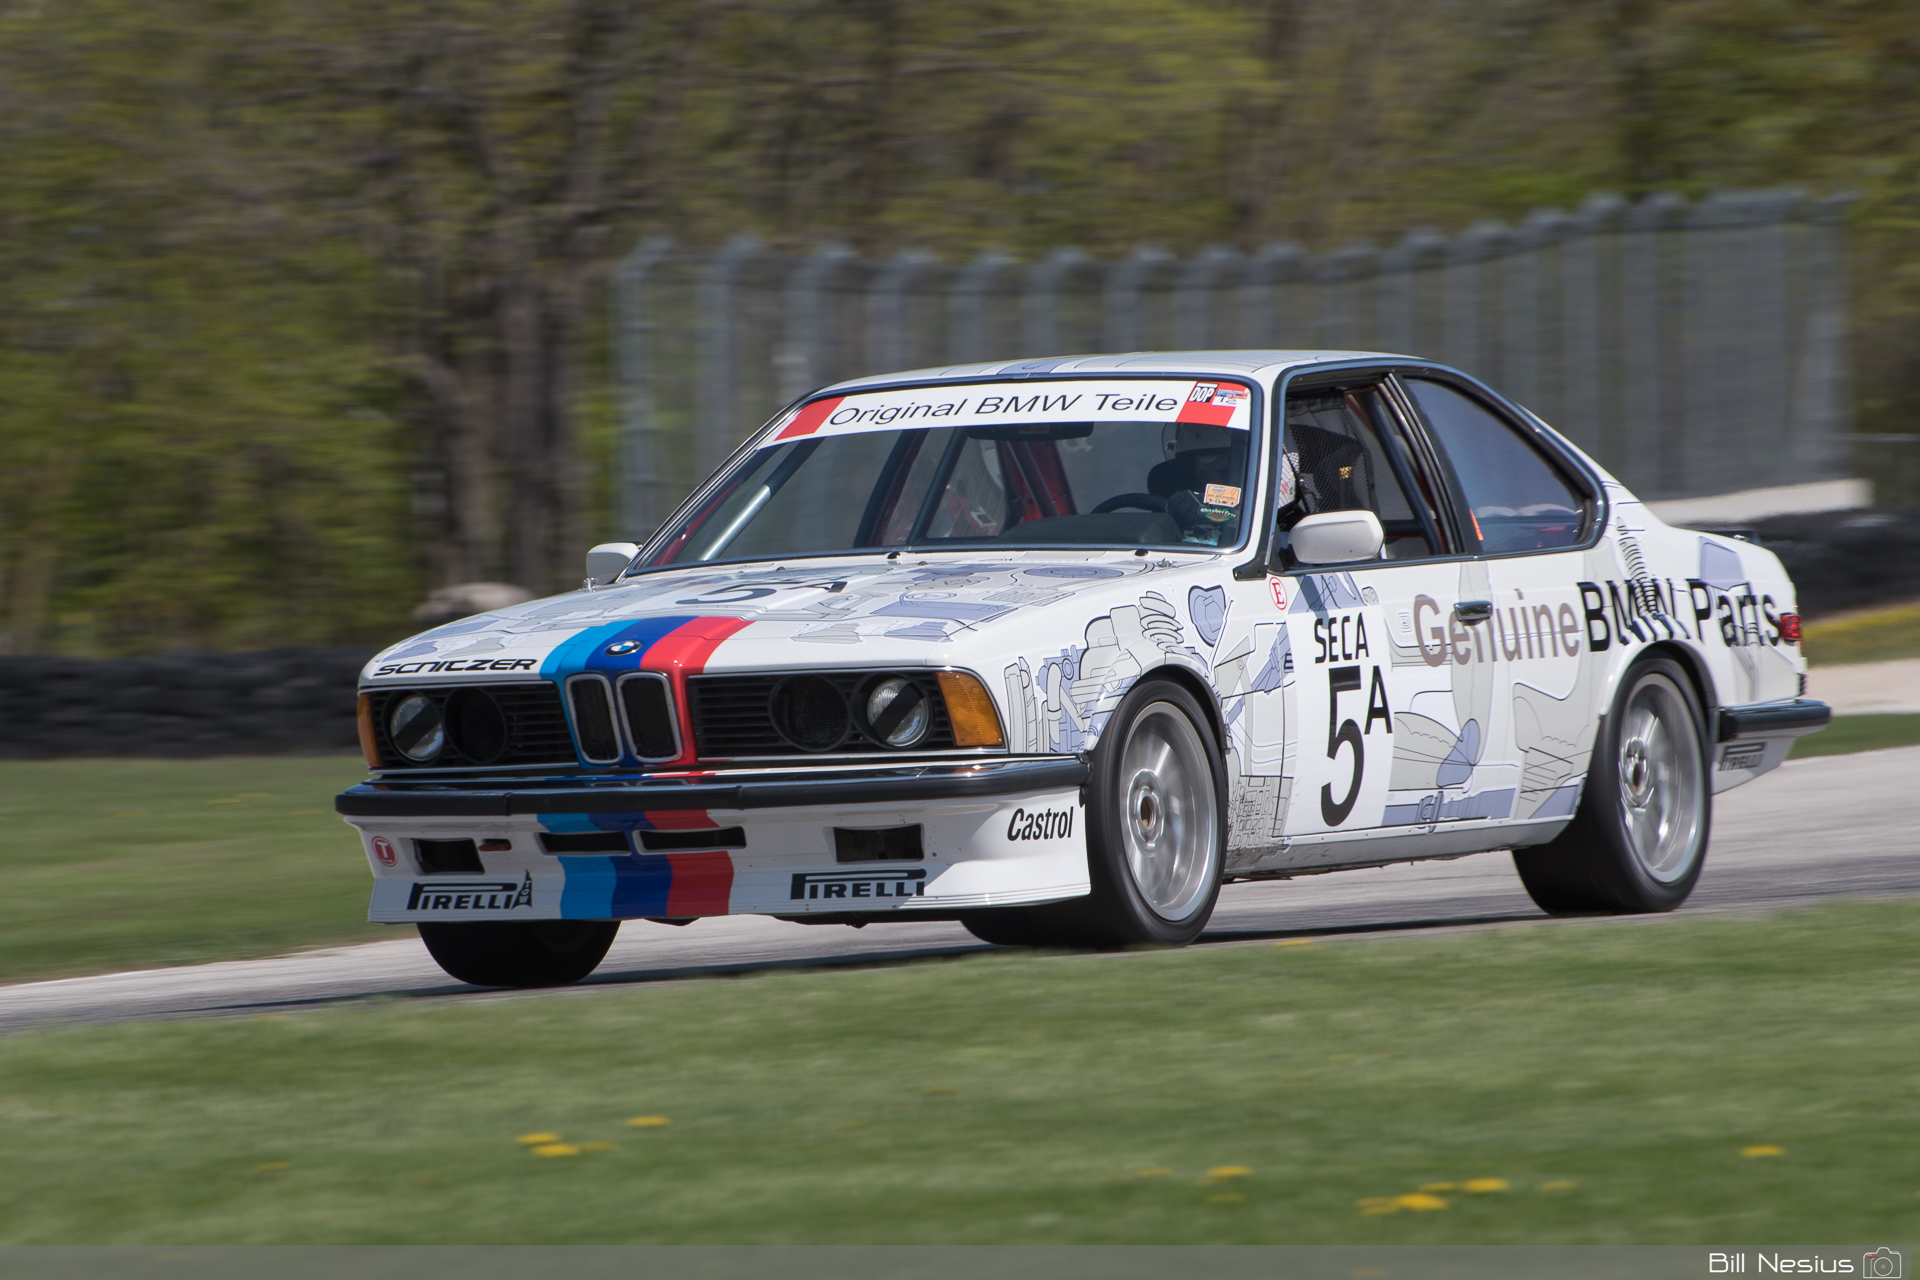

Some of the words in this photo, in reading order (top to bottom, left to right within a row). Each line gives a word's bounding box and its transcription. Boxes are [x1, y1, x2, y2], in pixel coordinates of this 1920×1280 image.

[830, 398, 969, 426] Original
[975, 393, 1083, 415] BMW
[1095, 393, 1178, 411] Teile
[1188, 386, 1216, 403] DOP
[1272, 580, 1284, 605] E
[1314, 612, 1369, 664] SECA
[1413, 588, 1580, 668] Genuine
[1577, 577, 1691, 653] BMW
[1685, 578, 1780, 648] Parts
[1007, 806, 1074, 841] Castrol
[407, 883, 518, 911] PIRELLI
[790, 868, 927, 900] PIRELLI
